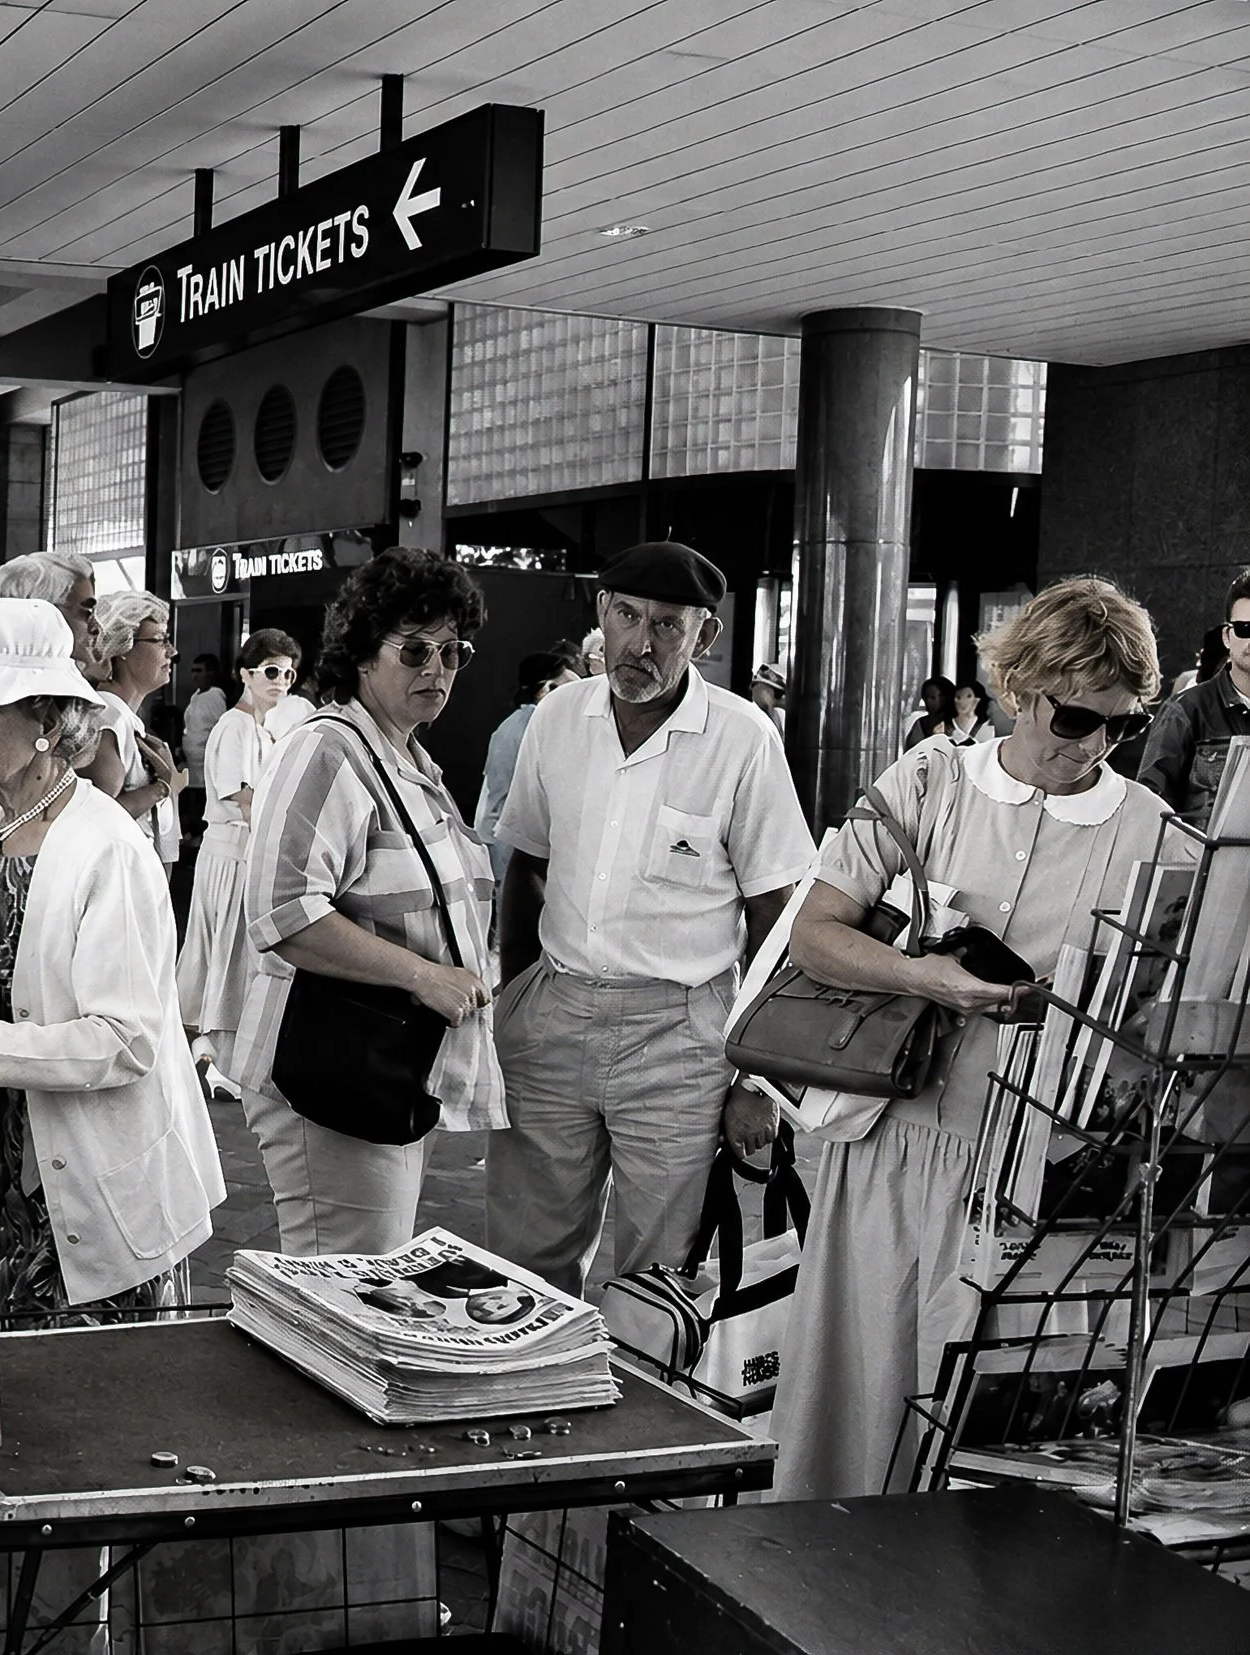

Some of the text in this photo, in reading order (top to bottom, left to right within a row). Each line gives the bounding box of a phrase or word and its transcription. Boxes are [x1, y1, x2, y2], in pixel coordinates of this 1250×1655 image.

[176, 204, 371, 323] TRAIN TICKETS
[232, 548, 323, 580] TRAIN TICKETS
